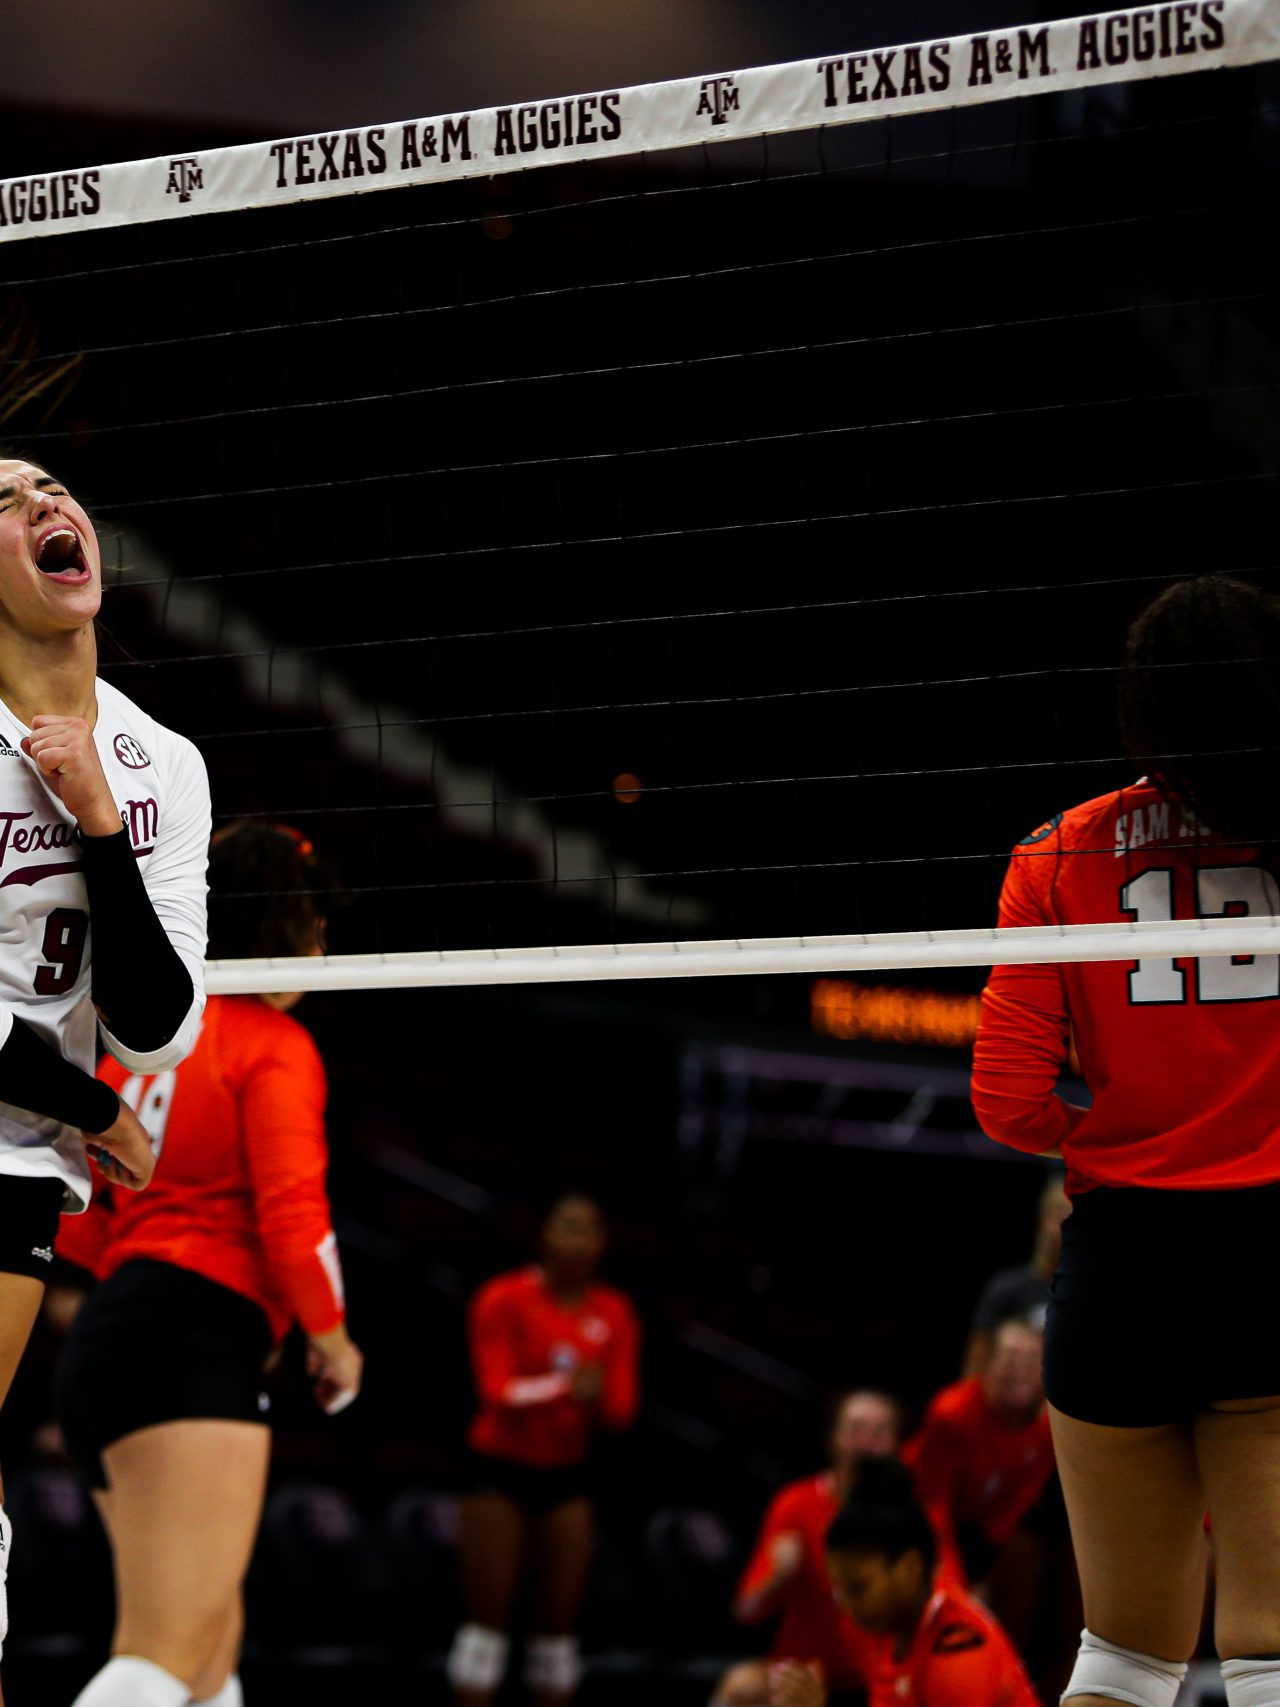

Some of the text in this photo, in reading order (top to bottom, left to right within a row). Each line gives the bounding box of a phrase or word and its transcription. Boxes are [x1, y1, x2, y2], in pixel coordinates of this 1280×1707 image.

[817, 2, 1224, 108] TEXAS A&M AGGIES
[270, 93, 622, 188] TEXAS A&M AGGIES
[1114, 802, 1170, 858] SAM
[33, 907, 90, 996] 9
